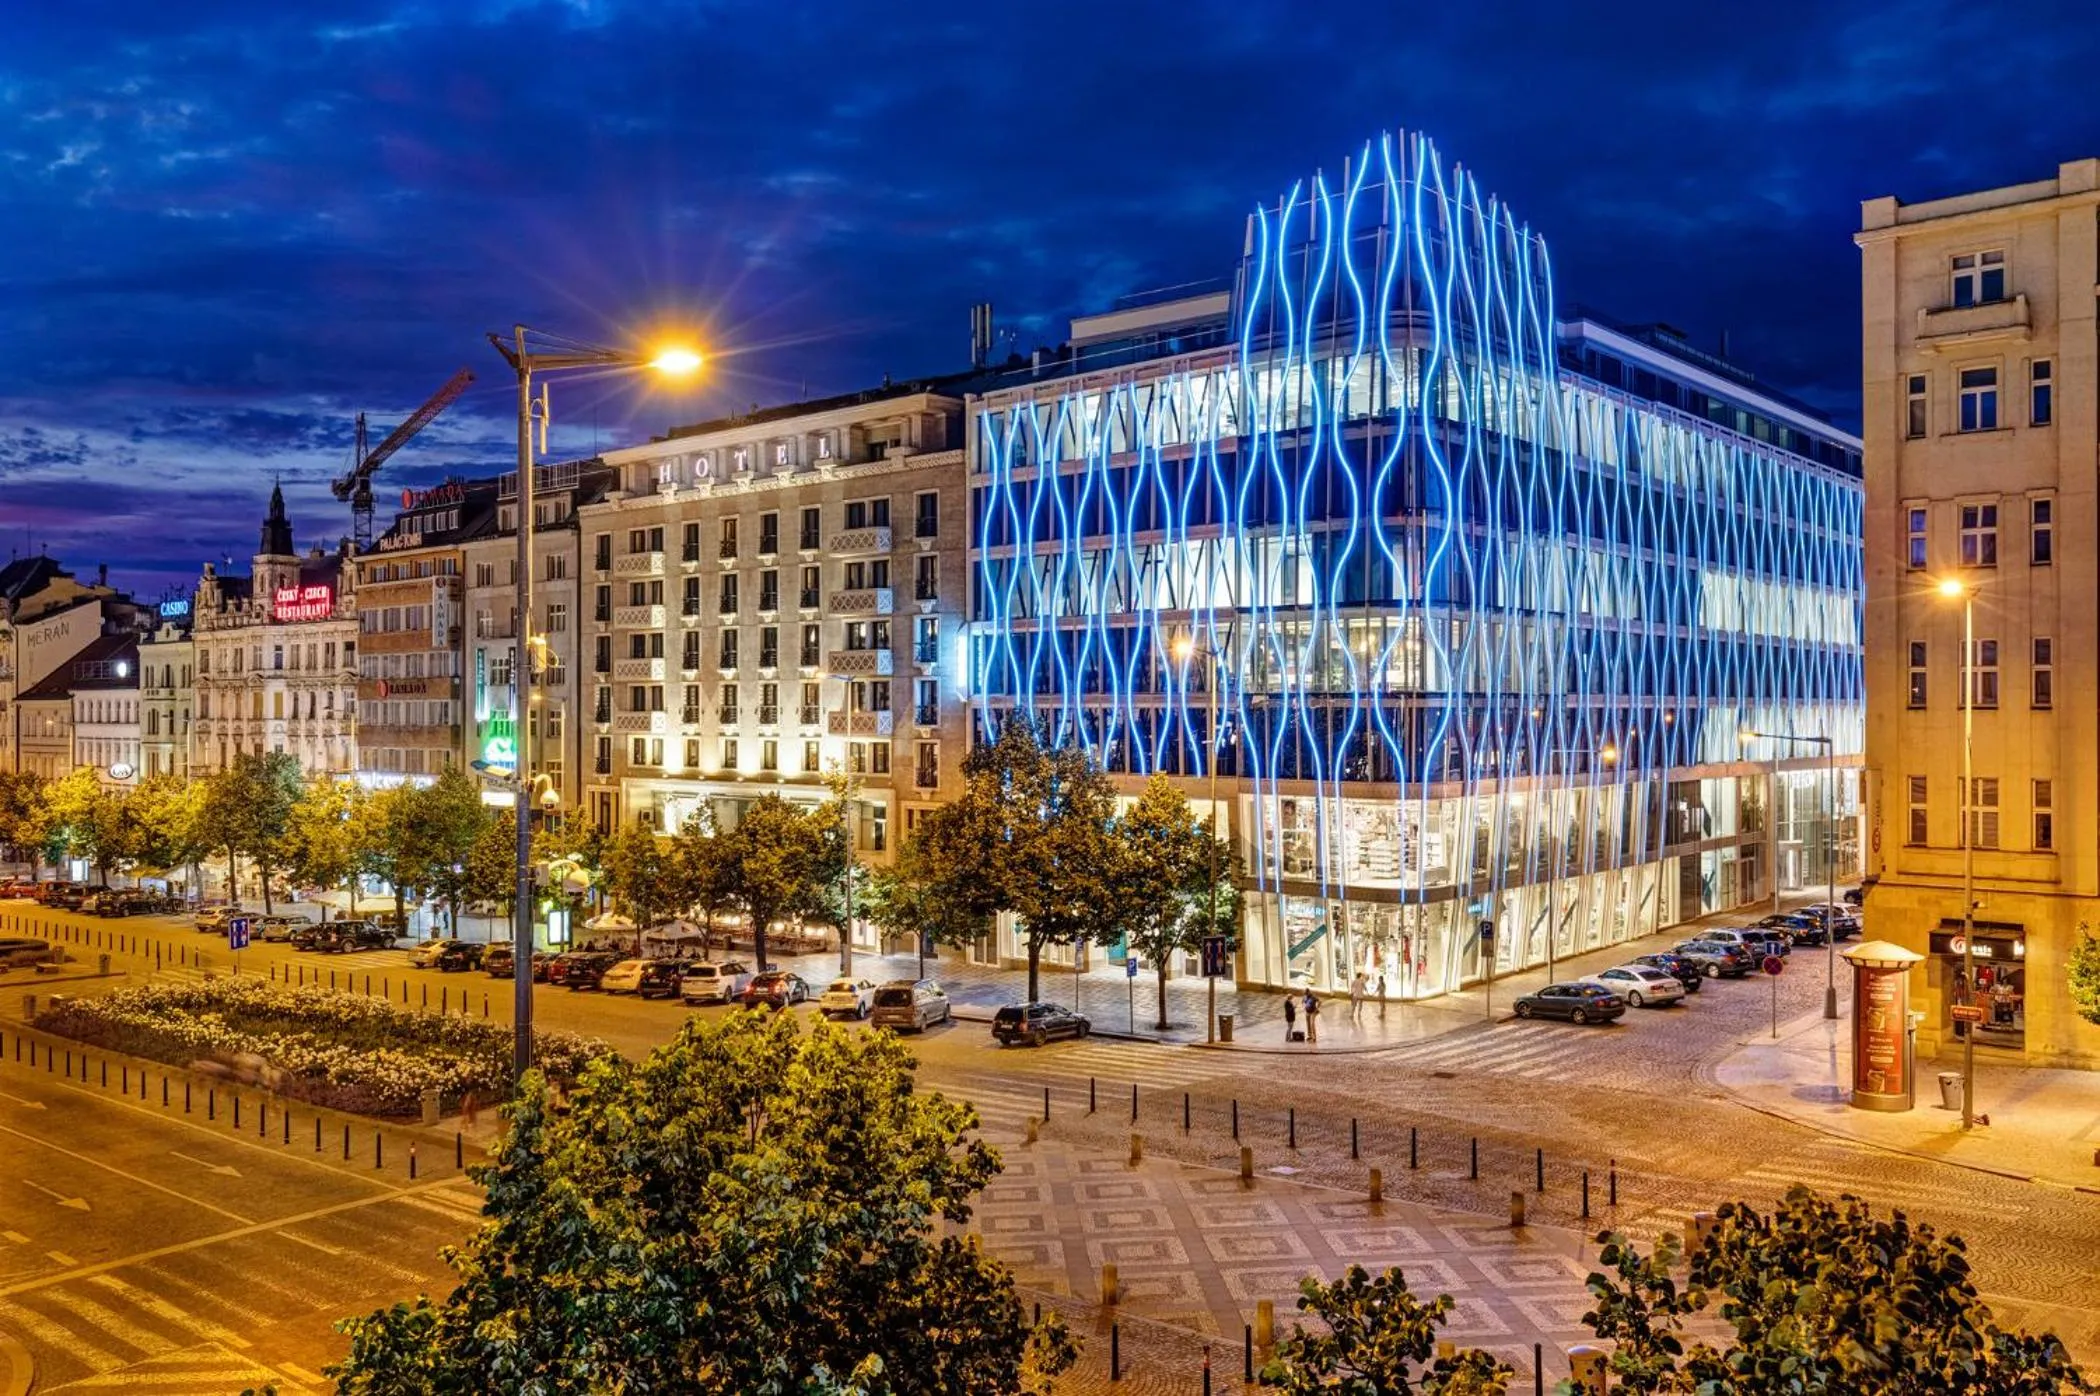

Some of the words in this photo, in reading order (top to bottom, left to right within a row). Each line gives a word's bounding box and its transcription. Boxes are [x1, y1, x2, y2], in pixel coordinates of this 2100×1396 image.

[659, 437, 829, 484] HOTEL
[413, 484, 465, 507] RAMADA
[160, 600, 189, 617] CASINO
[27, 622, 70, 648] MERAN
[390, 682, 427, 694] RAMADA
